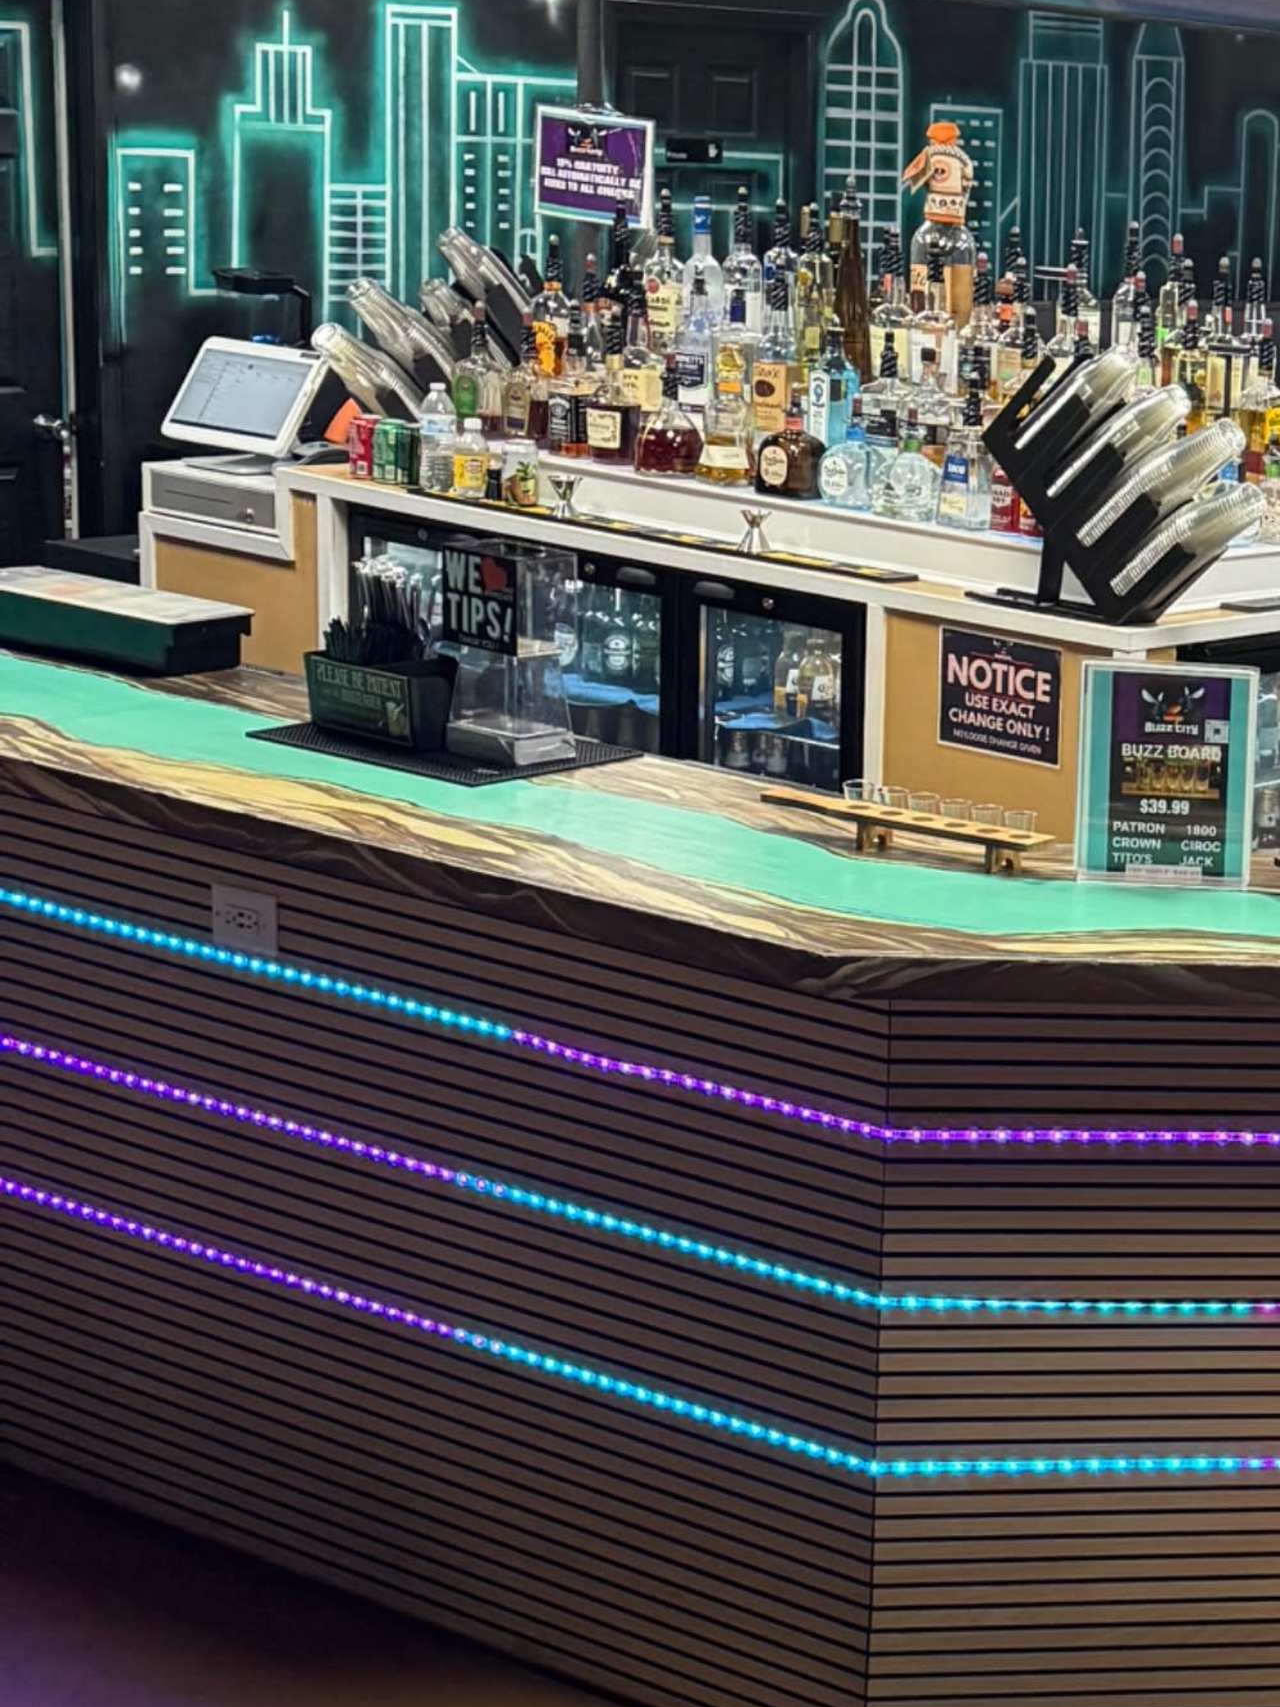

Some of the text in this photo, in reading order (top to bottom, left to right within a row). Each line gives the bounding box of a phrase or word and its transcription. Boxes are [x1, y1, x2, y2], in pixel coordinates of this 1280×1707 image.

[445, 549, 481, 594] WE
[447, 592, 513, 643] TIPS!
[317, 663, 350, 687] PLEASE
[946, 653, 1053, 703] NOTICE
[965, 691, 1036, 719] USE EXACT
[948, 707, 1004, 732] CHANGE
[1006, 720, 1042, 740] ONLY
[1121, 742, 1222, 763] BUZZ BOARD
[1139, 798, 1190, 816] $39.99
[1112, 820, 1217, 838] PATRON 1800
[1112, 836, 1222, 853] CROWN CIROC
[1112, 851, 1214, 868] TITO'S JACK
